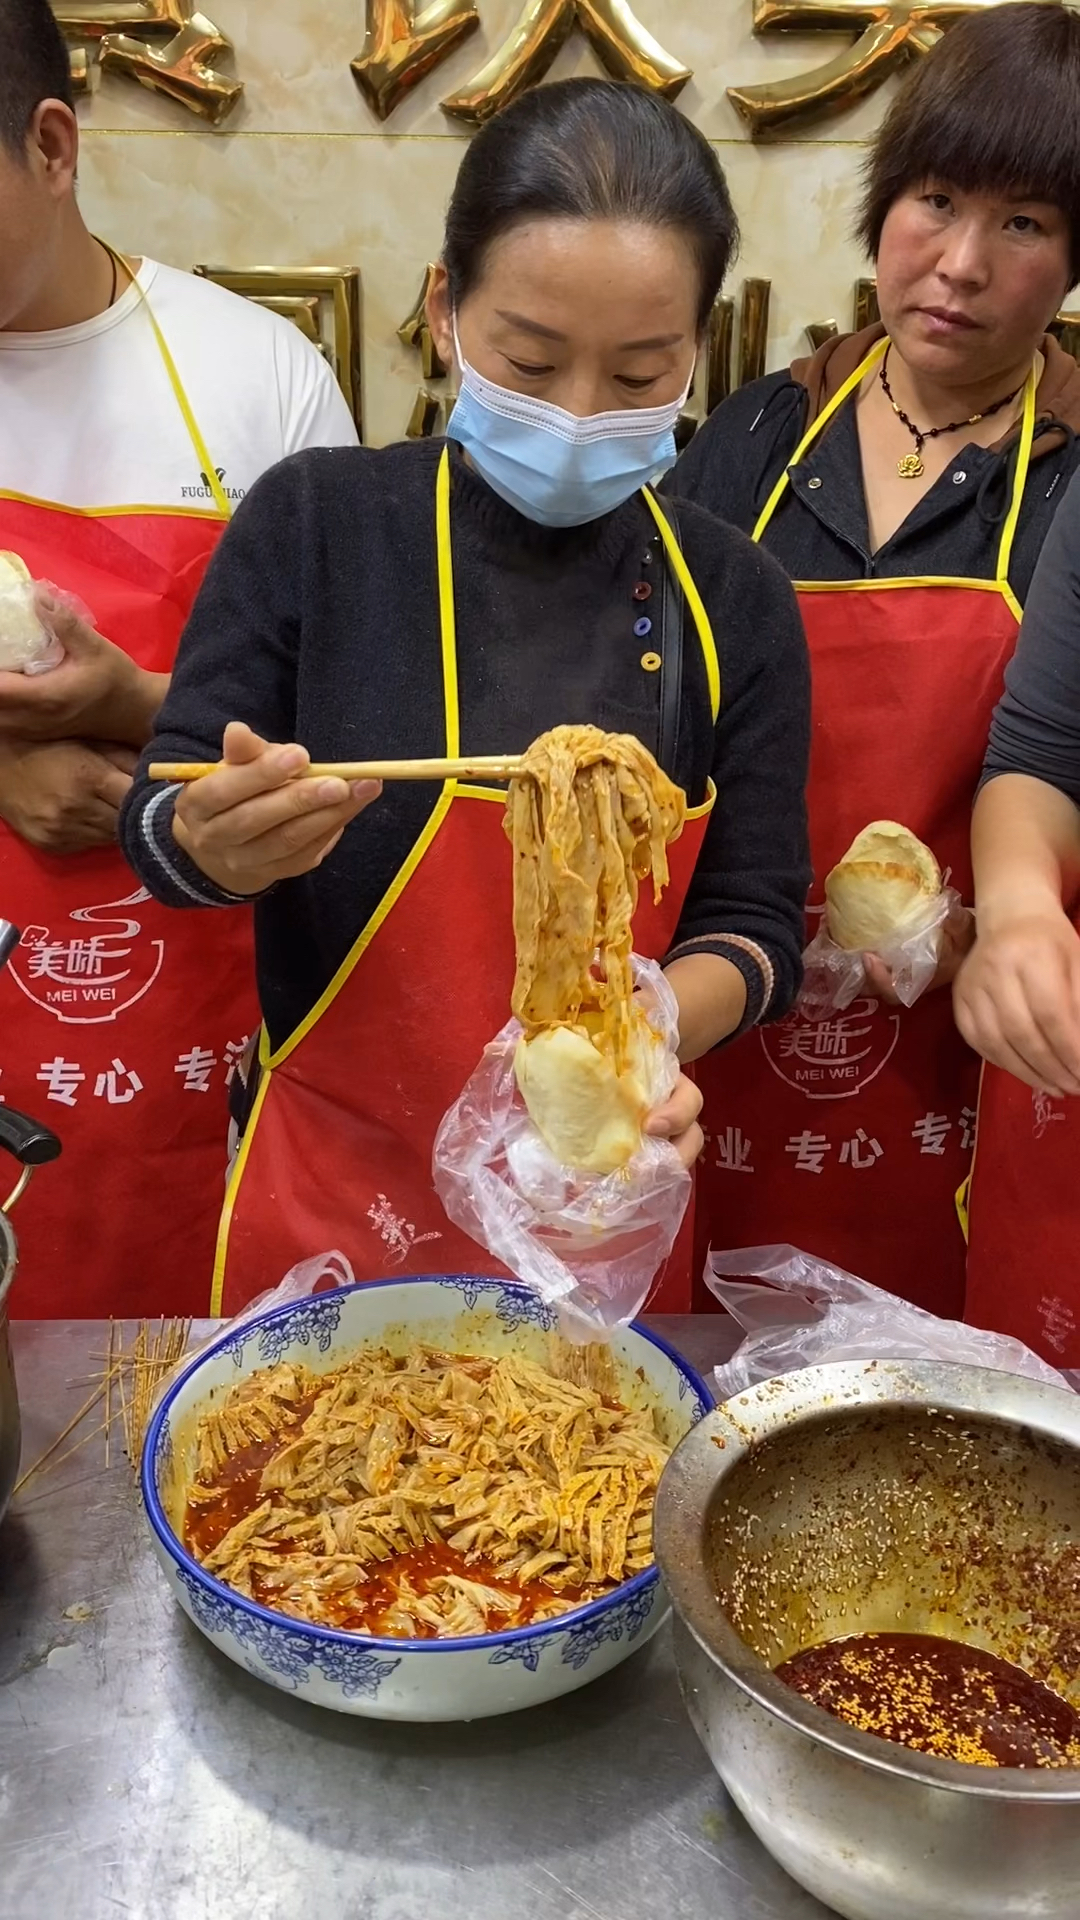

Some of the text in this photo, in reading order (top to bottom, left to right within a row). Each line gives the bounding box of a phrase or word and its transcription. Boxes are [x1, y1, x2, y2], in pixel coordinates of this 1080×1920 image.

[28, 938, 106, 979] 美味
[46, 988, 116, 1002] MEI WEI
[778, 1020, 850, 1057] 美味
[36, 1056, 144, 1106] 专心
[795, 1066, 859, 1080] MEI WEI
[696, 1124, 754, 1173] 业
[785, 1128, 884, 1174] 专心
